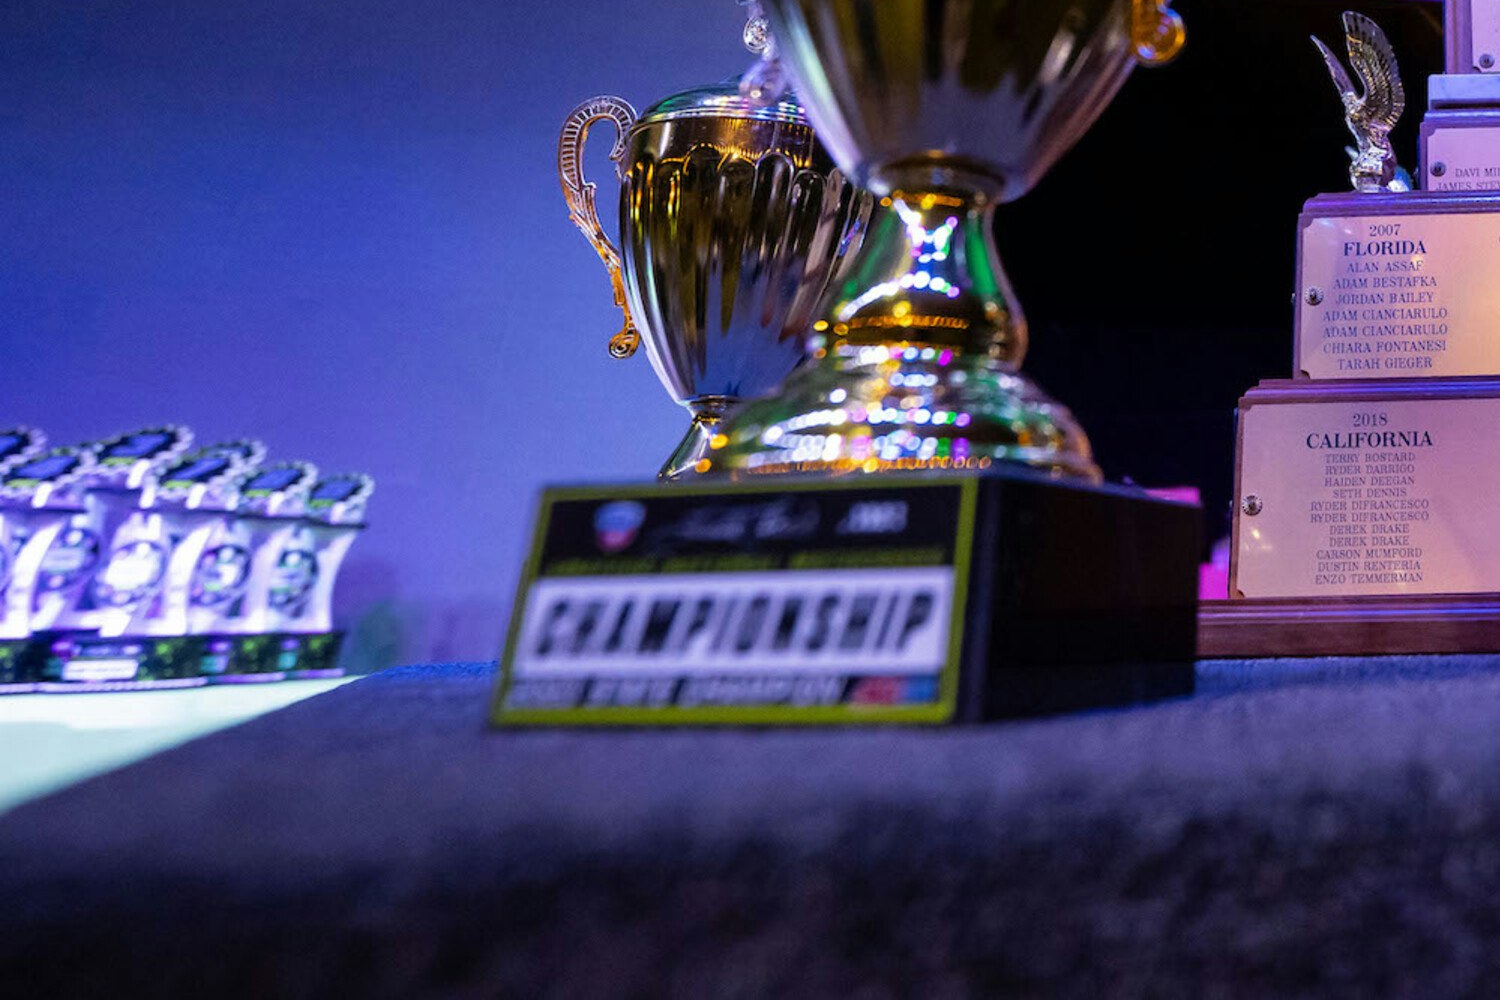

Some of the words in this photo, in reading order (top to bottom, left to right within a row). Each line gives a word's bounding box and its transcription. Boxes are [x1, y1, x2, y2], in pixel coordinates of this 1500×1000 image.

[1455, 168, 1480, 177] DAVI
[1369, 224, 1401, 236] 2007
[1343, 240, 1426, 256] FLORIDA
[1347, 262, 1379, 273] ALAN
[1385, 260, 1424, 271] ASSAF
[1333, 278, 1368, 289] ADAM
[1373, 277, 1437, 288] BESTAFKA
[1335, 294, 1385, 305] JORDAN
[1389, 292, 1434, 303] BAILEY
[1323, 311, 1358, 322] ADAM
[1362, 308, 1448, 320] CIANCIARULO
[1323, 328, 1357, 338] ADAM
[1362, 324, 1448, 337] CIANCIARULO
[1324, 343, 1371, 354] CHIARA
[1376, 340, 1446, 352] FONTANESI
[1337, 359, 1380, 370] TARAH
[1385, 357, 1433, 369] GIEGER
[1353, 413, 1388, 427] 2018
[1306, 431, 1433, 449] CALIFORNIA
[1324, 454, 1360, 464] TERRY
[1365, 452, 1416, 462] BOSTARD
[1325, 466, 1361, 475] RYDER
[1365, 464, 1415, 474] DARRIGO
[1324, 477, 1366, 487] HAIDEN
[1370, 476, 1415, 486] DEEGAN
[1333, 489, 1362, 499] SETH
[1366, 488, 1407, 498] DENNIS
[1310, 501, 1347, 511] RYDER
[1352, 500, 1429, 510] DIFRANCESCO
[1310, 513, 1347, 523] RYDER
[1352, 511, 1429, 522] DIFRANCESCO
[1329, 525, 1367, 535] DEREK
[1371, 524, 1410, 534] DRAKE
[1329, 537, 1367, 547] DEREK
[1371, 536, 1410, 546] DRAKE
[1316, 550, 1360, 560] CARSON
[1365, 548, 1422, 559] MUMFORD
[1318, 562, 1359, 572] DUSTIN
[1363, 560, 1421, 571] RENTERIA
[1315, 574, 1346, 585] ENZO
[1351, 573, 1423, 584] TEMMERMAN
